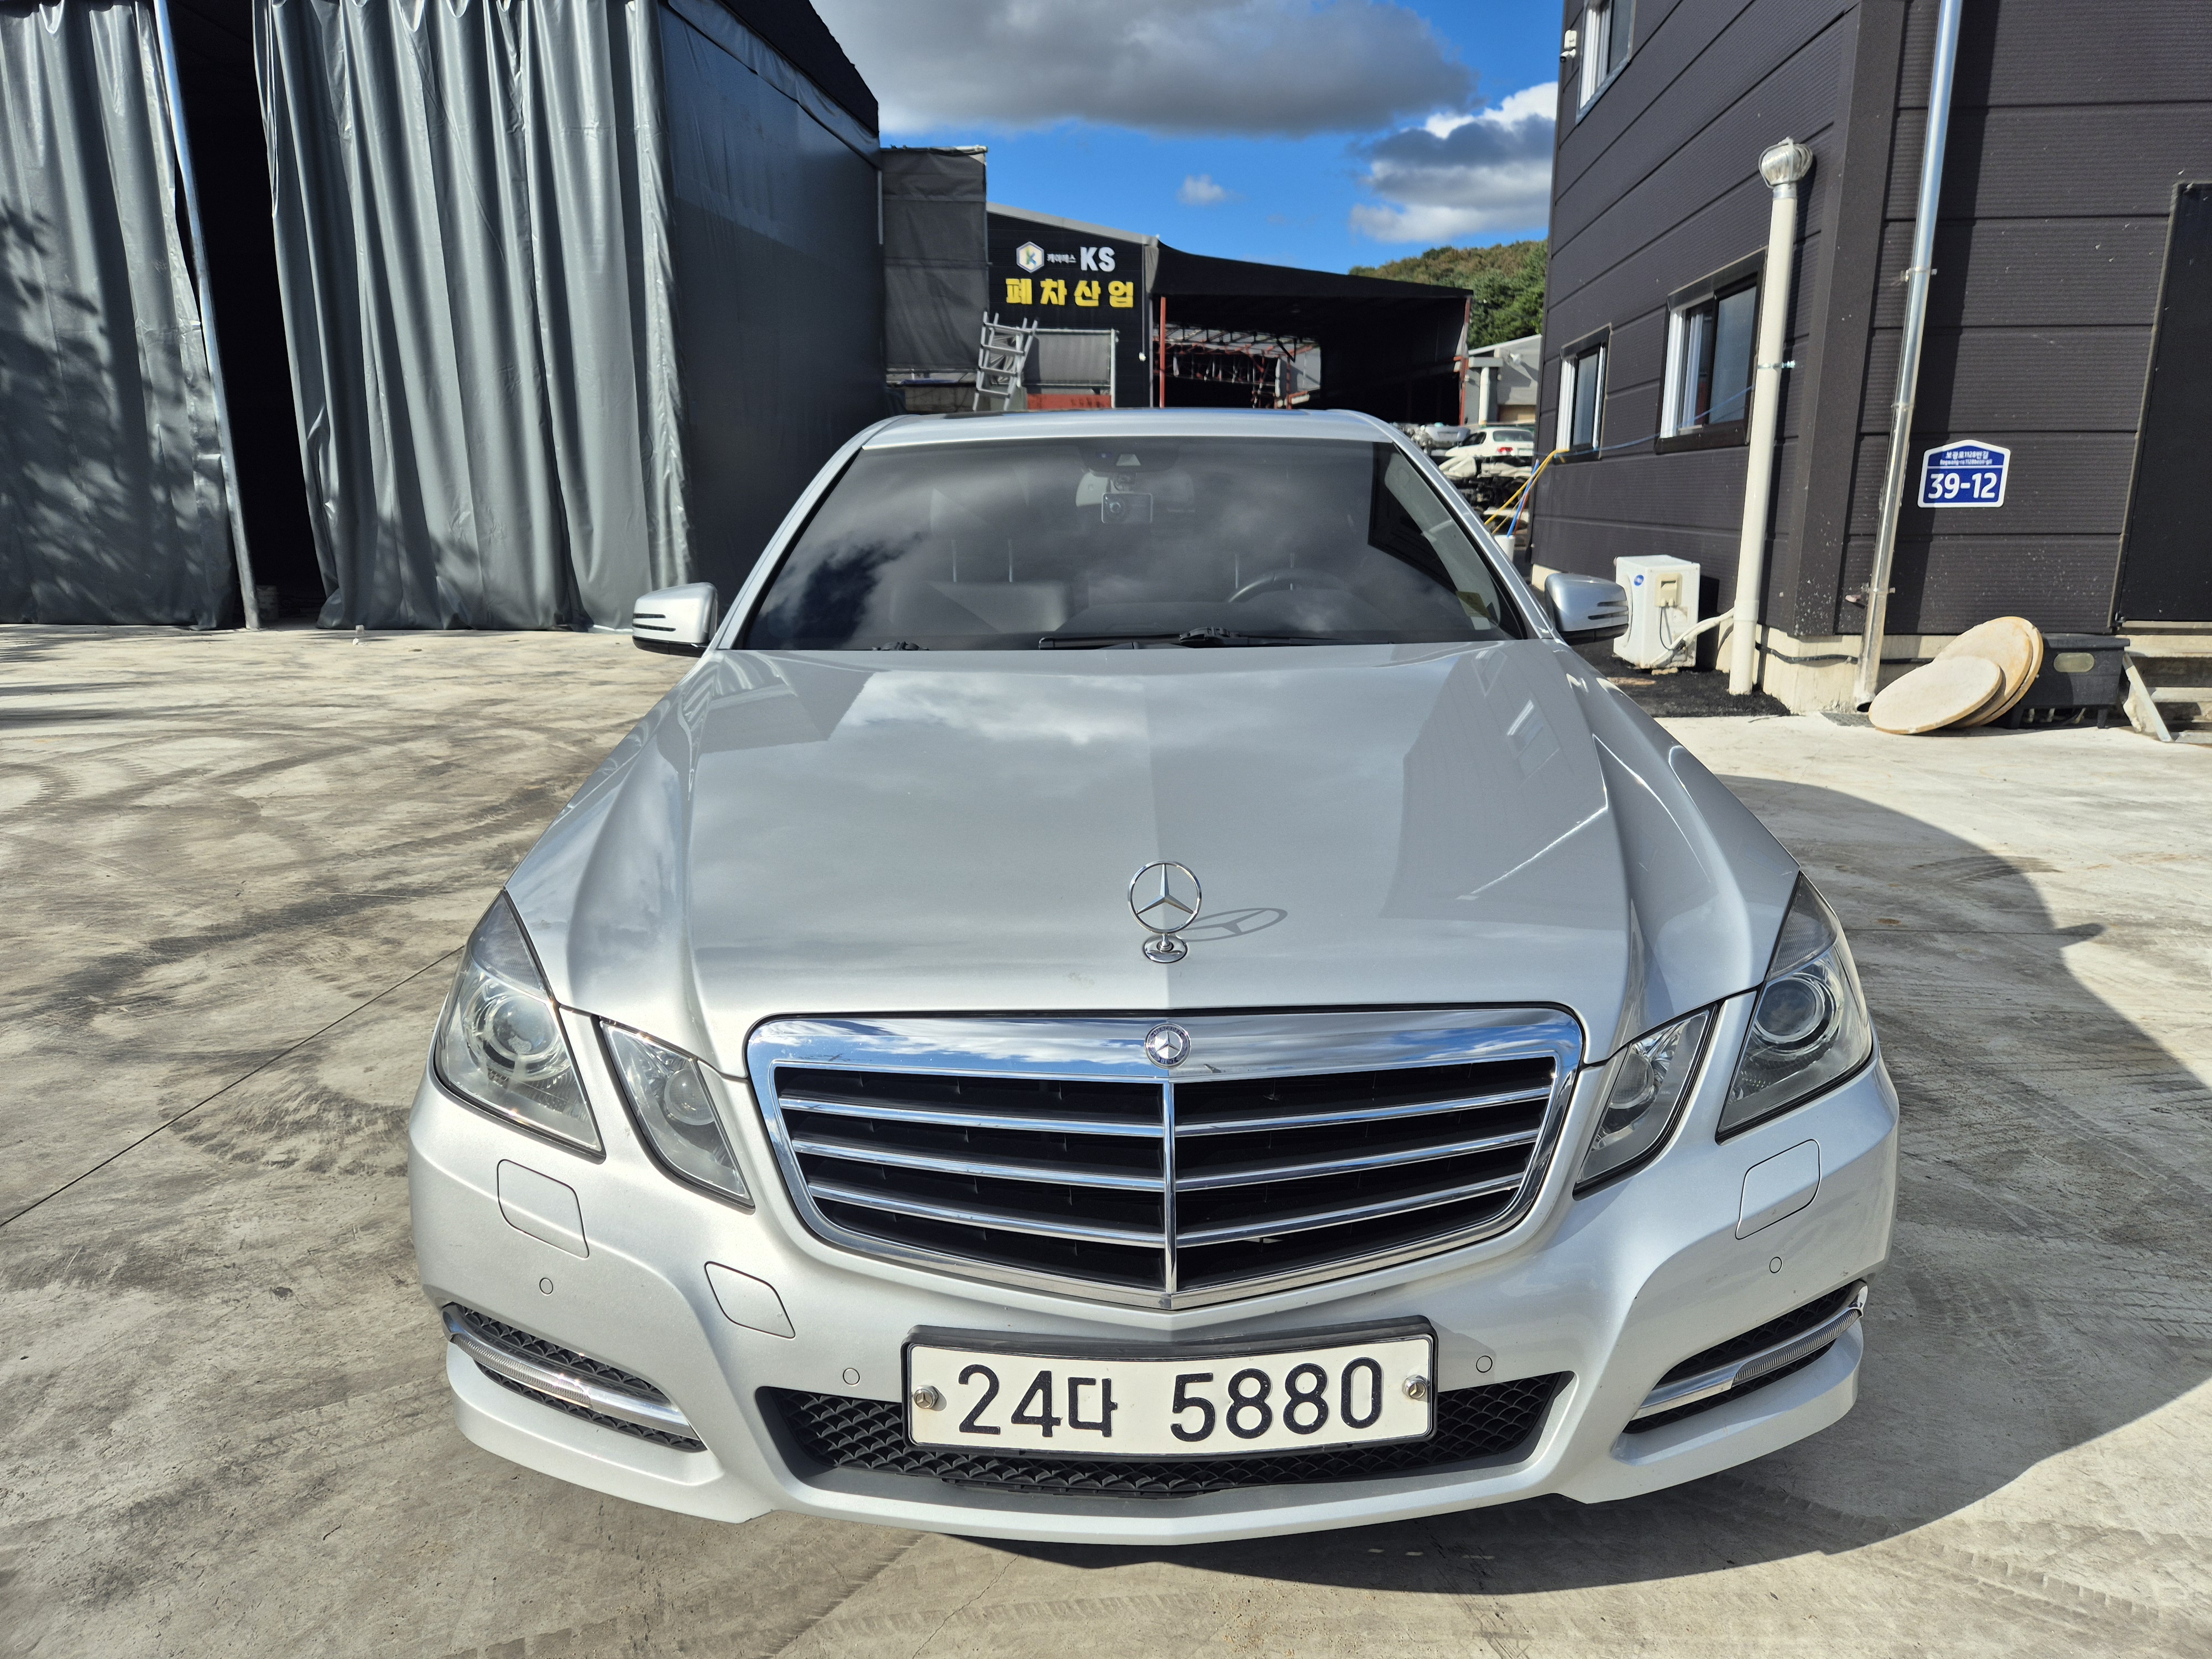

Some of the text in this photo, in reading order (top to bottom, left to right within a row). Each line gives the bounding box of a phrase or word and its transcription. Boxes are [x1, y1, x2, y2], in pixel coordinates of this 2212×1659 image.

[1080, 247, 1116, 273] KS
[1005, 278, 1134, 308] 폐차산업
[1928, 472, 1997, 499] 39-12
[1154, 1026, 1182, 1035] MERCEDES
[959, 1357, 1384, 1442] 24다 5880
